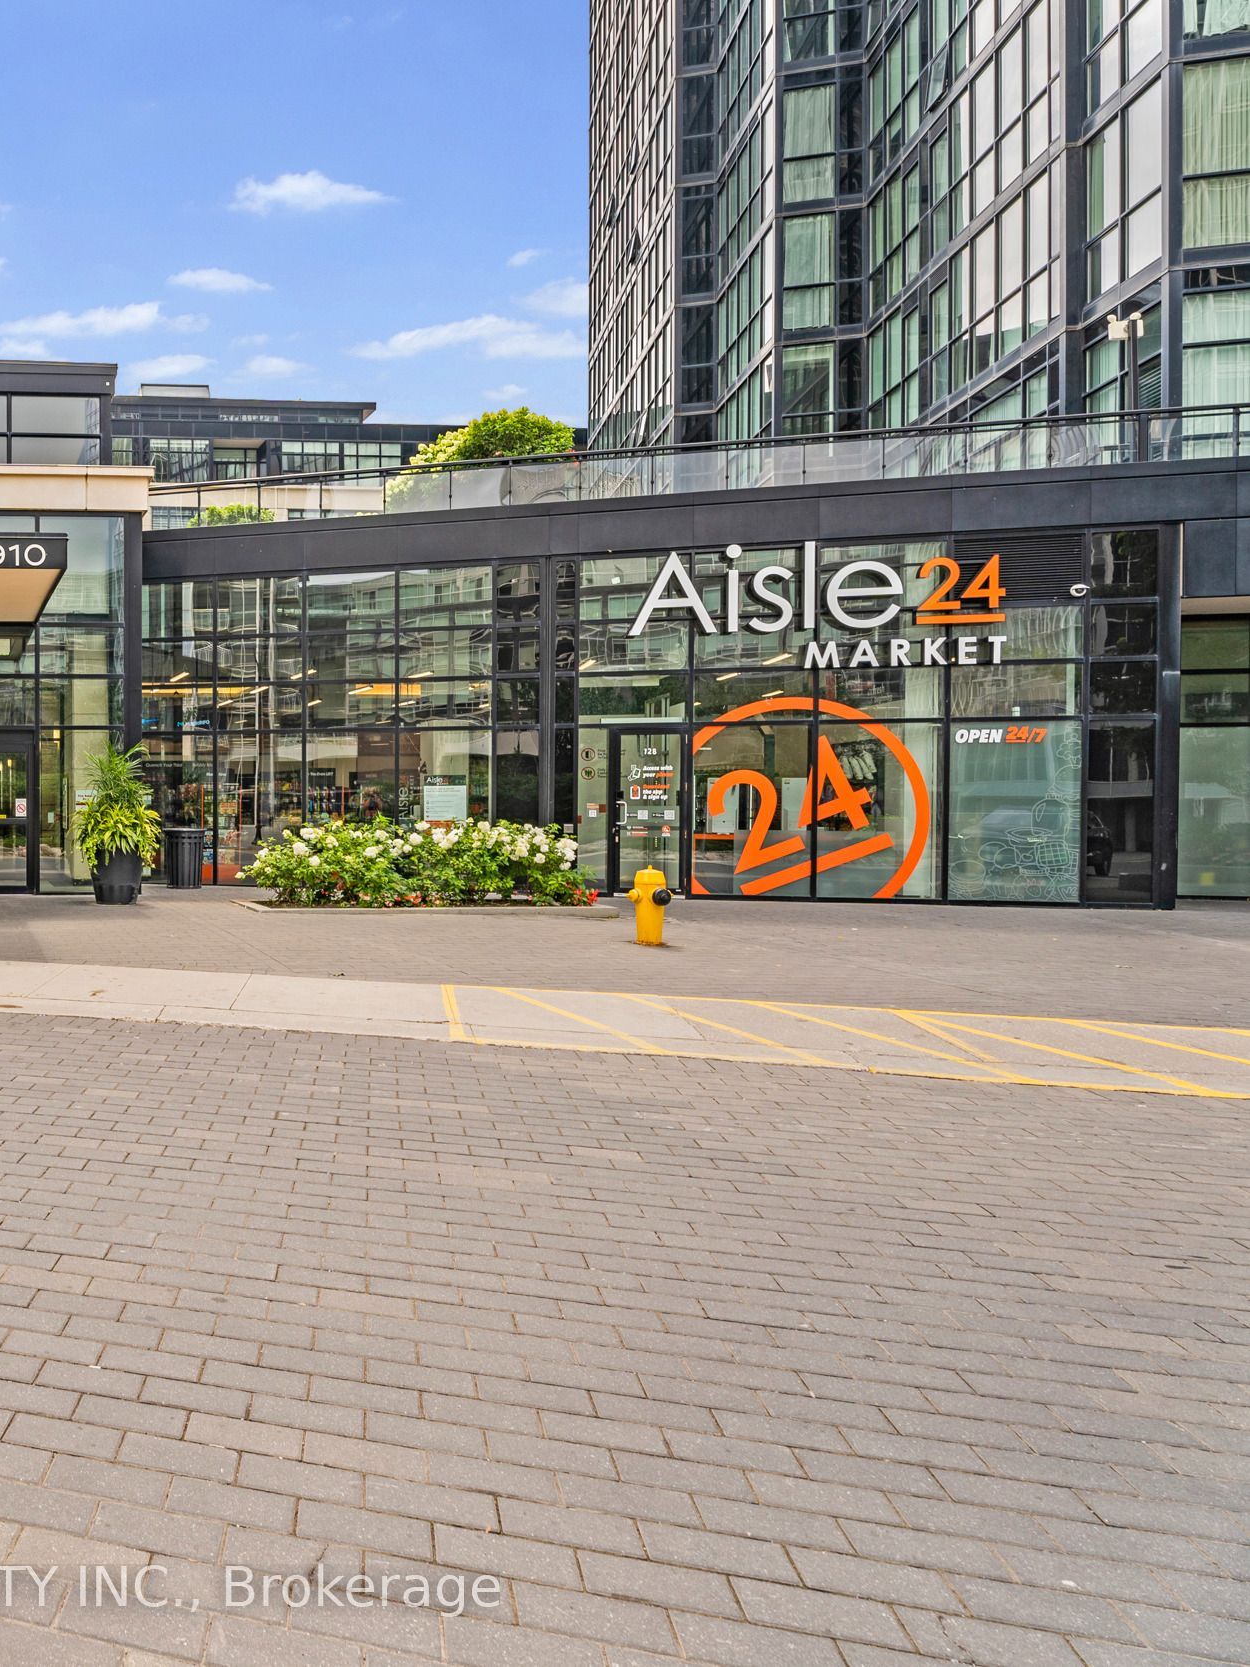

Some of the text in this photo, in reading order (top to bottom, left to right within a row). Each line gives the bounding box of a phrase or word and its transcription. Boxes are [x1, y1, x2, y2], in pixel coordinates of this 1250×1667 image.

[627, 541, 1006, 637] Aisle 24
[803, 636, 1007, 669] MARKET
[955, 725, 1047, 743] OPEN 24/7
[426, 776, 443, 785] Aisle
[398, 787, 409, 820] Aisle
[707, 735, 872, 875] 24
